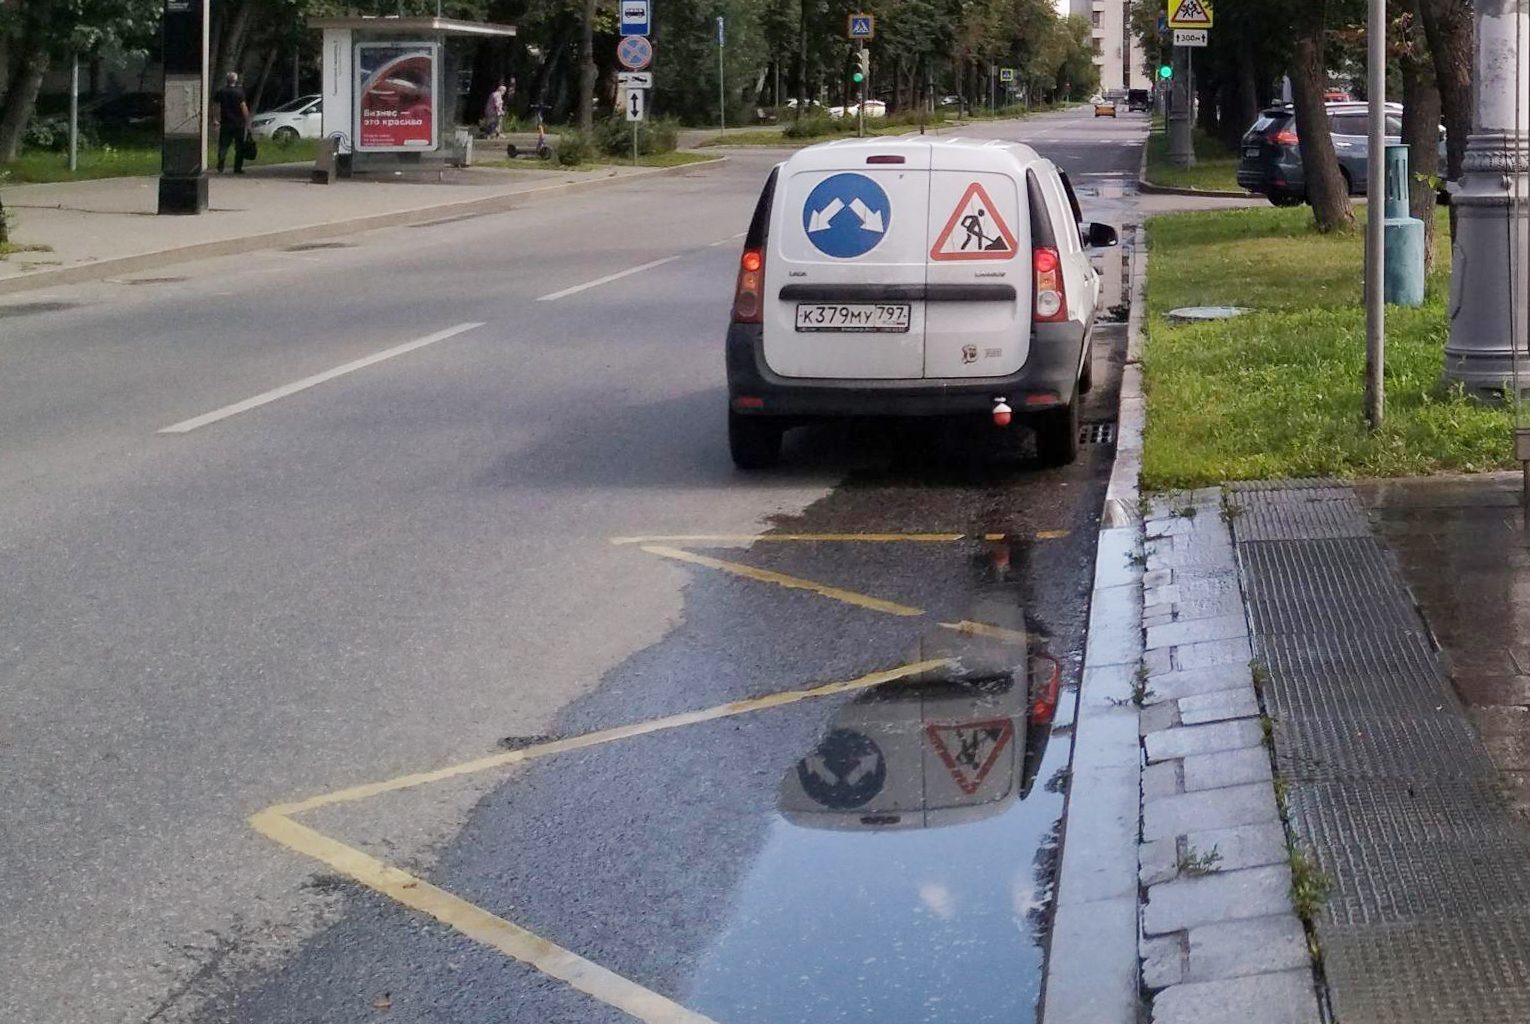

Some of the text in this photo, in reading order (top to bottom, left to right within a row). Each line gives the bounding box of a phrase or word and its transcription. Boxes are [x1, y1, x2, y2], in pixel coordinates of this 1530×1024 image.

[364, 109, 398, 117] Бизнес
[382, 118, 423, 127] красиво
[876, 306, 905, 321] 797
